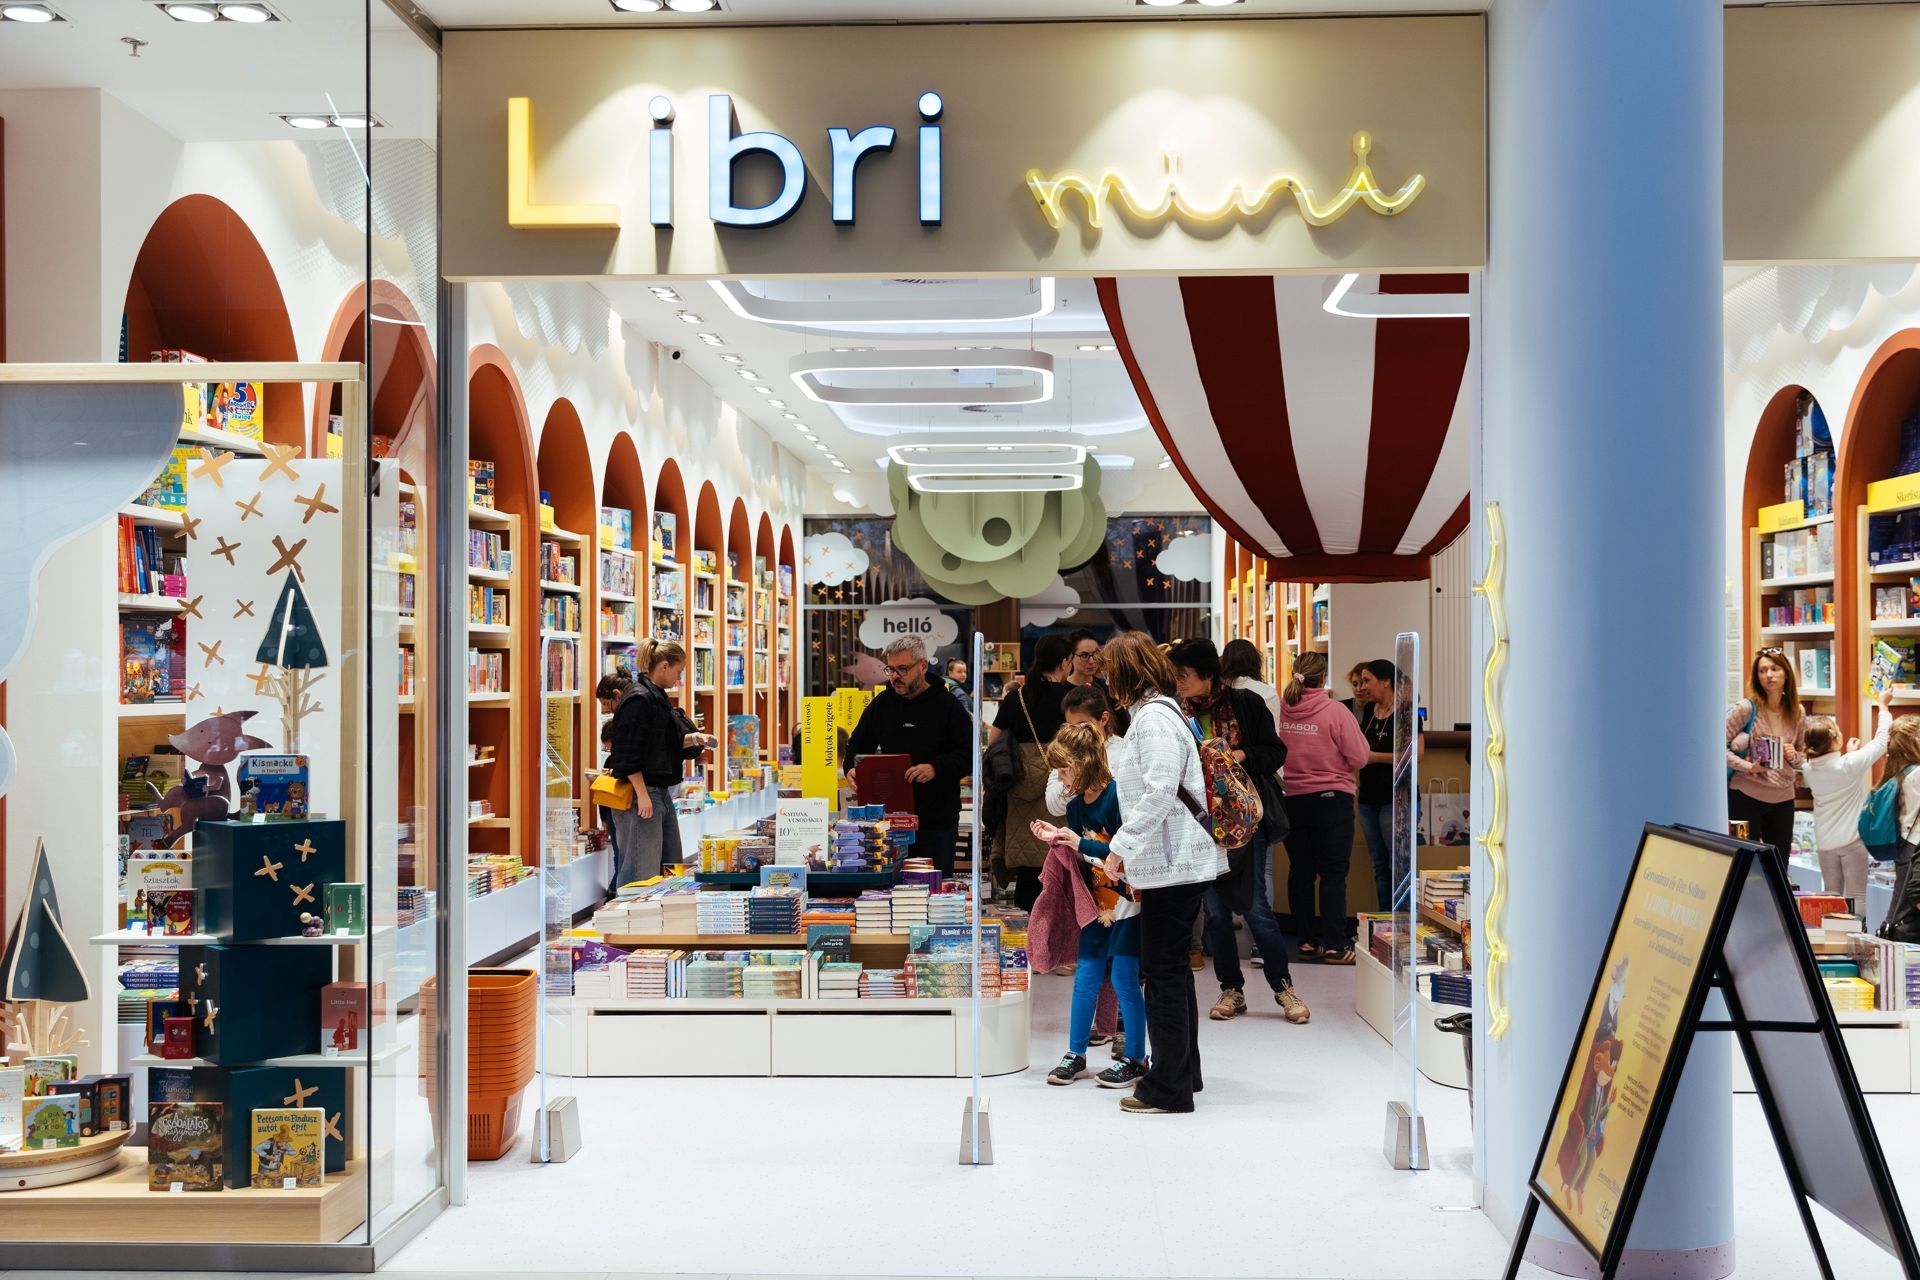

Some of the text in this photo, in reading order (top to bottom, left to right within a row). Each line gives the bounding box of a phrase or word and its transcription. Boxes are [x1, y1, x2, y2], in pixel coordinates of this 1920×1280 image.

[508, 91, 944, 229] Libri
[1025, 129, 1427, 230] mini
[883, 616, 932, 633] helló
[804, 702, 812, 726] évesek
[825, 702, 836, 767] Molyok szigete
[252, 759, 294, 767] Kismackó
[256, 1114, 284, 1123] Pettson
[291, 1113, 318, 1123] Findusz
[257, 1124, 278, 1133] autót
